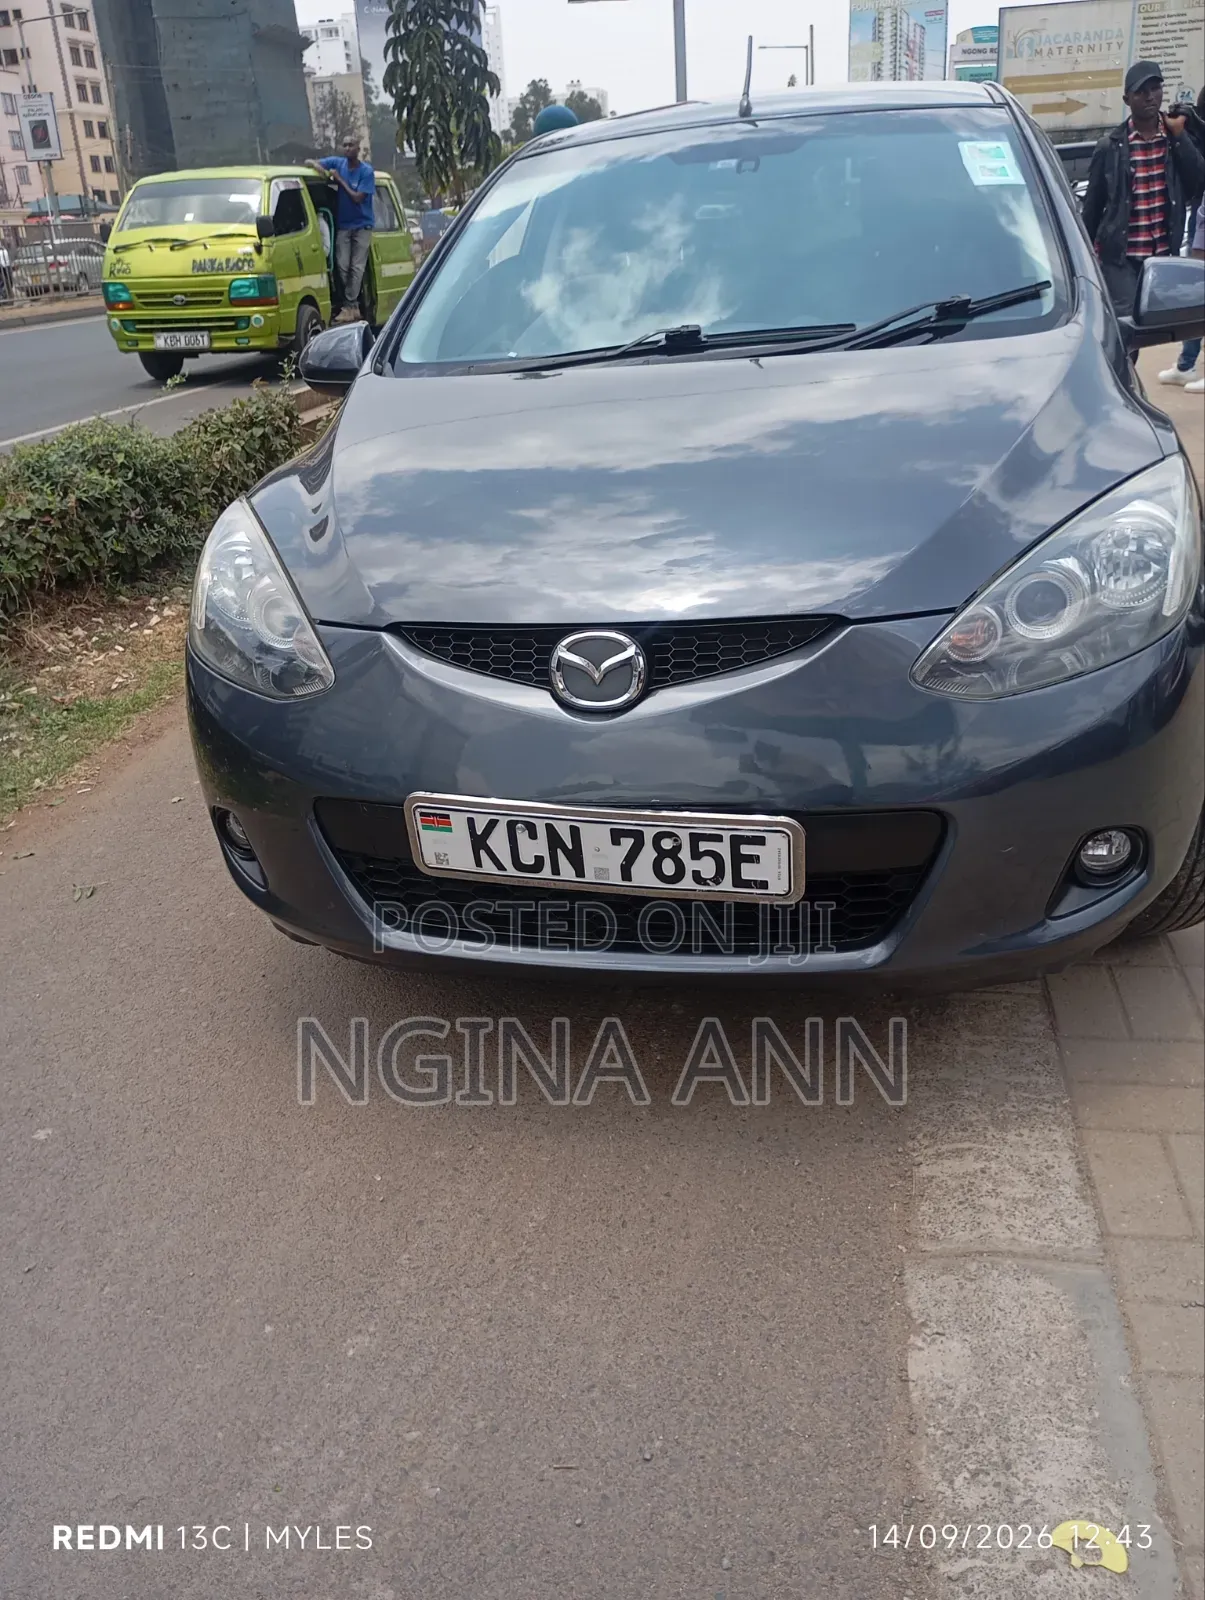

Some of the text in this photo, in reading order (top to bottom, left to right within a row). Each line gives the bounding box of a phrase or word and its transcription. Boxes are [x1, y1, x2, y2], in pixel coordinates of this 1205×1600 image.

[1140, 3, 1161, 13] OUR
[1036, 28, 1125, 47] JACARANDA
[1034, 41, 1124, 58] MATERNITY
[466, 815, 586, 879] KCN
[609, 827, 769, 890] 785E
